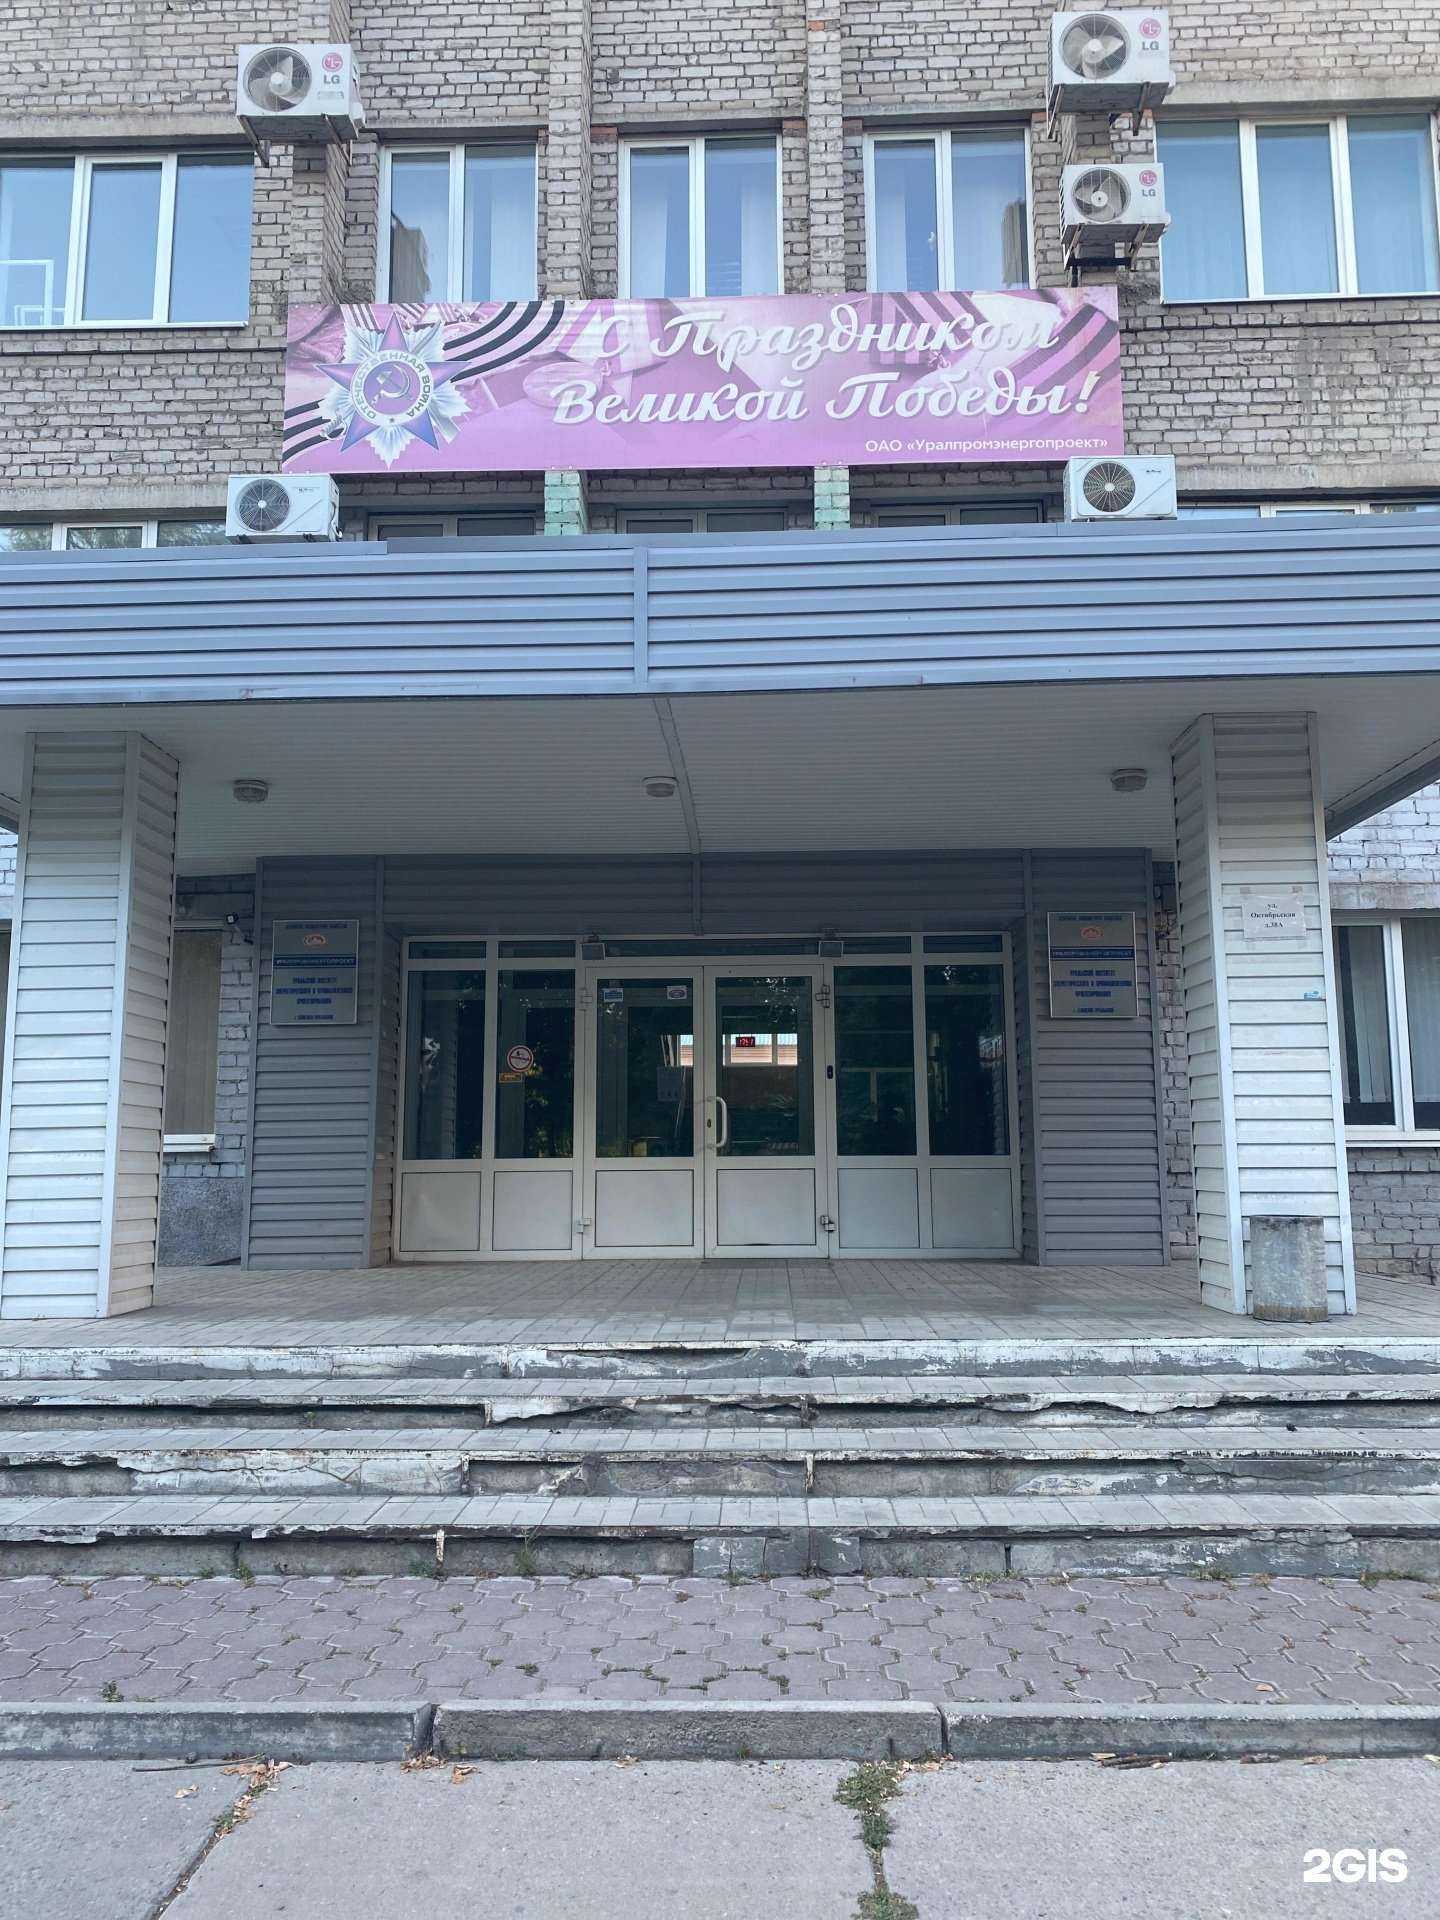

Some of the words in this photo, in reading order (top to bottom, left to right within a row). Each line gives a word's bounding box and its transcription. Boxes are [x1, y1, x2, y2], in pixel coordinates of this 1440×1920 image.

[1141, 41, 1160, 51] LG
[323, 74, 340, 85] LG
[1141, 189, 1156, 197] LG
[598, 315, 631, 358] С
[649, 296, 1060, 373] Праздником
[550, 376, 808, 425] Великой
[825, 366, 1101, 420] Победы!
[865, 439, 901, 452] ОАО
[907, 438, 1108, 454] «Уралпромэнергопроект»
